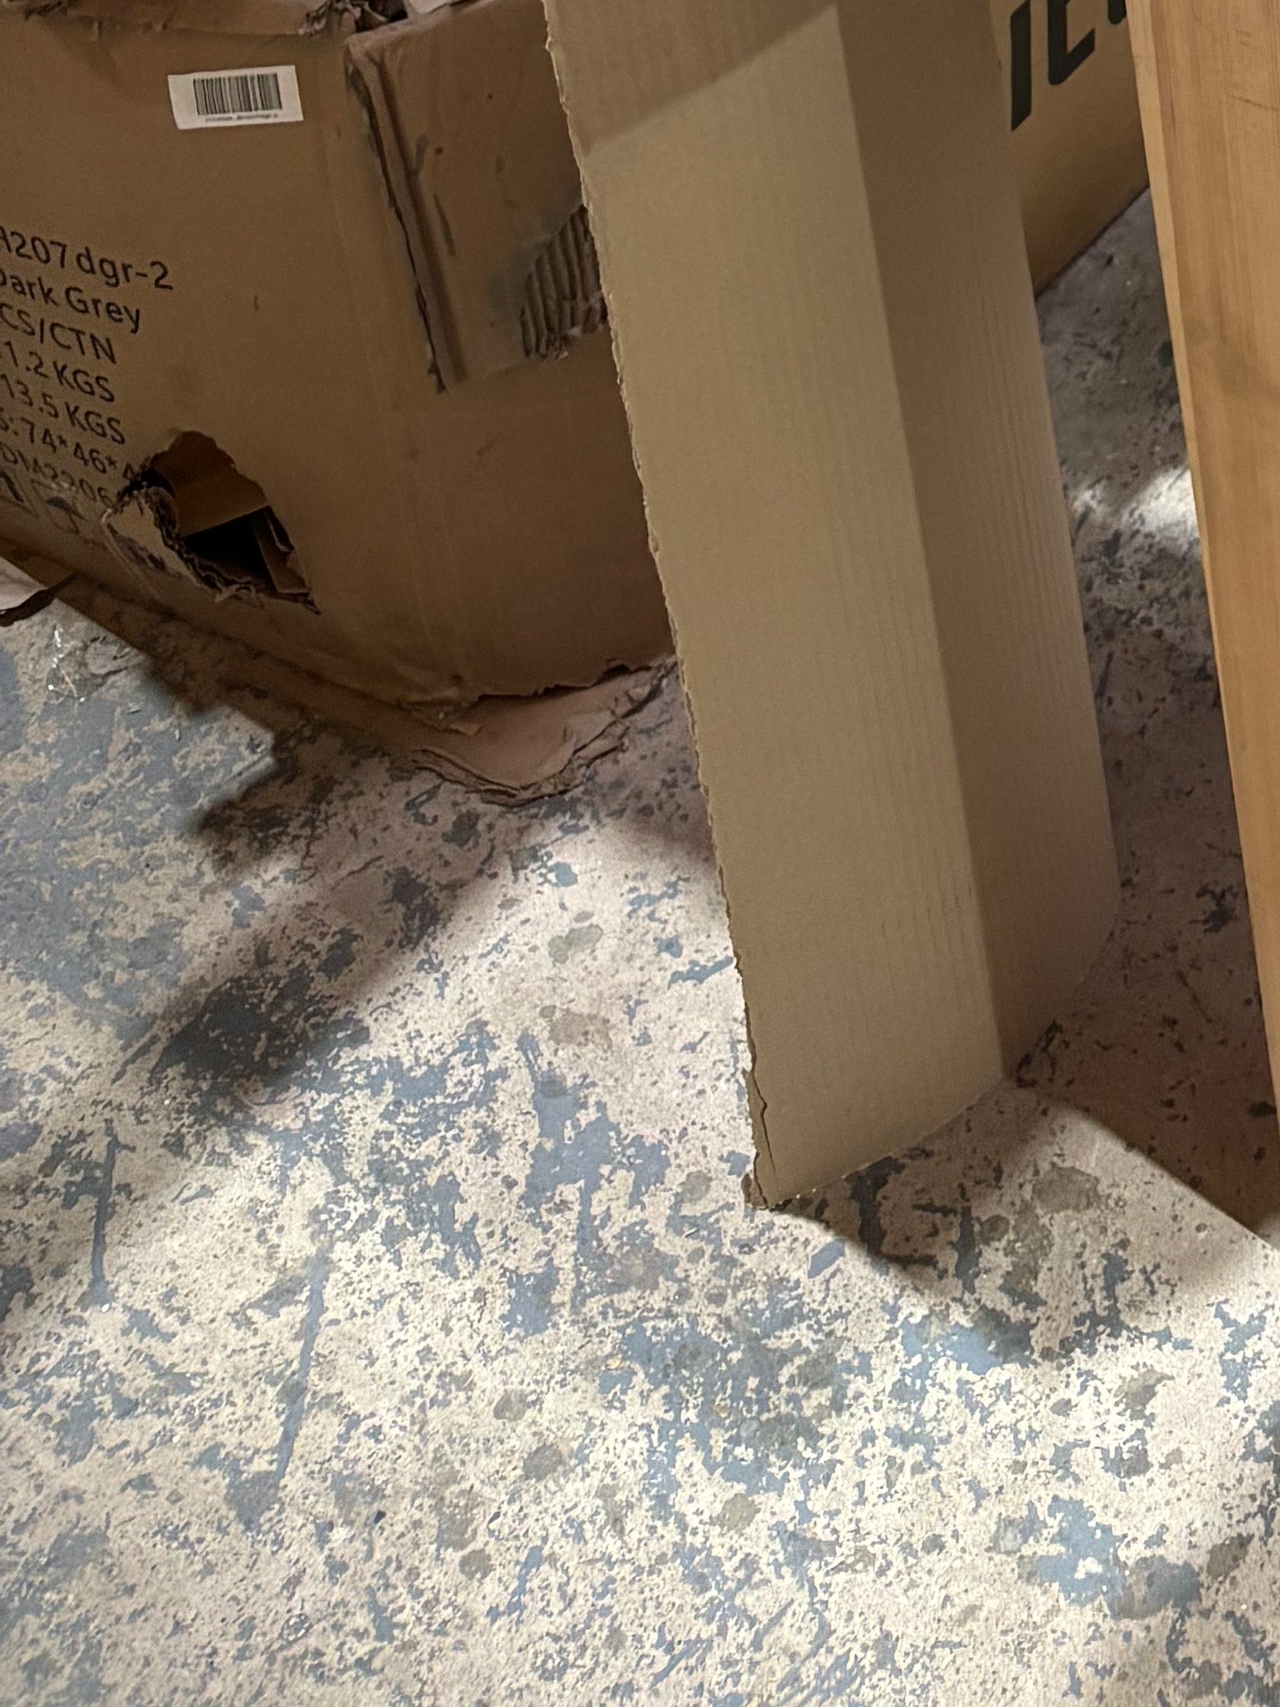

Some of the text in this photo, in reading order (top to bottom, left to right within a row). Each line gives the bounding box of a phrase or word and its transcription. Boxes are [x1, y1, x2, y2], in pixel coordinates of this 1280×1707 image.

[65, 286, 141, 334] Grey
[53, 360, 115, 403] KGS
[65, 401, 126, 445] KGS
